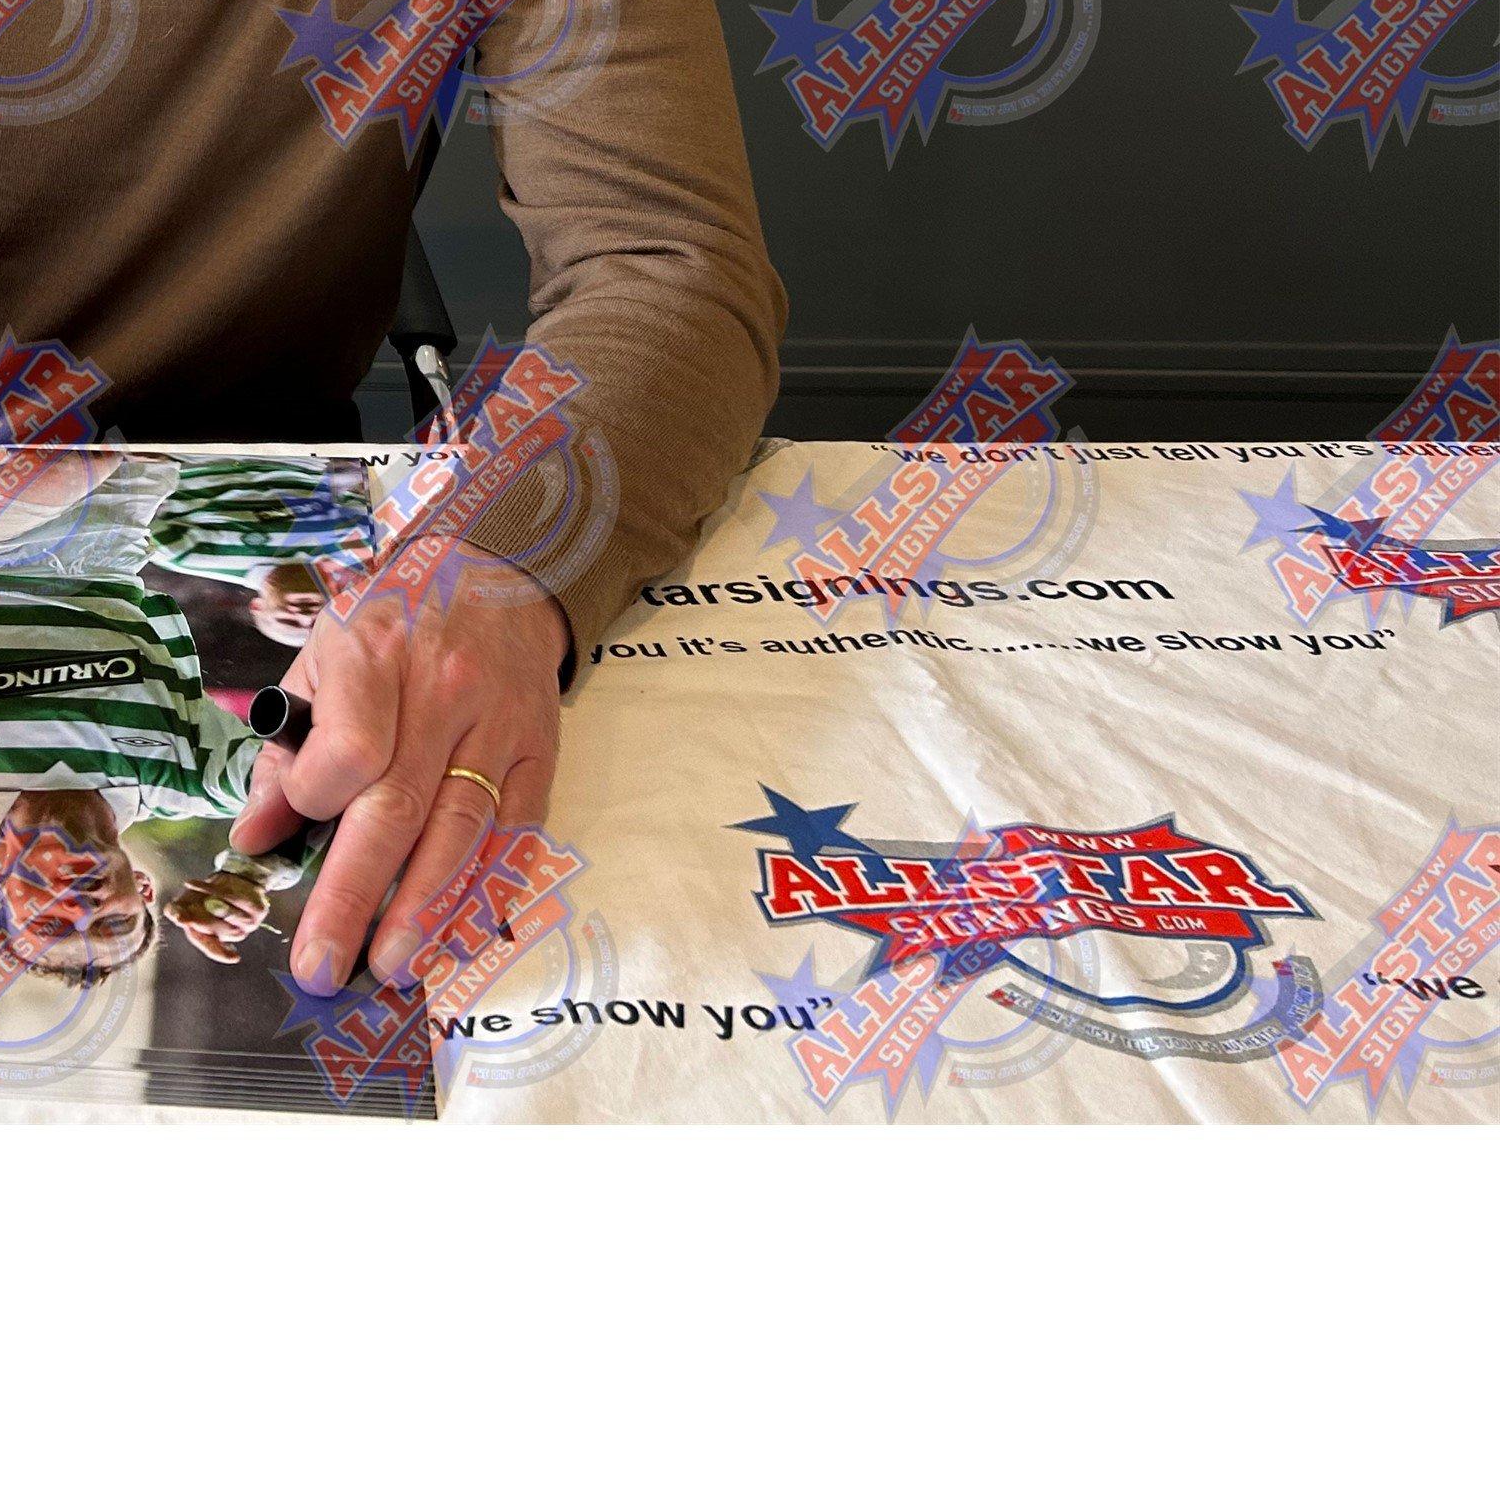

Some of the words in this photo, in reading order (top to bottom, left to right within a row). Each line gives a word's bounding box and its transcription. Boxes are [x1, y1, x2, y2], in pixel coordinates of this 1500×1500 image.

[1067, 444, 1149, 465] just
[1152, 444, 1220, 462] tell
[1223, 444, 1306, 464] you
[1308, 442, 1374, 459] it’s
[590, 640, 668, 664] you
[676, 637, 748, 656] it’s
[1155, 631, 1283, 652] show
[1289, 628, 1396, 656] you”
[759, 847, 1304, 921] ALLSTAR
[431, 1012, 513, 1041] we
[530, 997, 686, 1029] show
[700, 996, 833, 1042] you”
